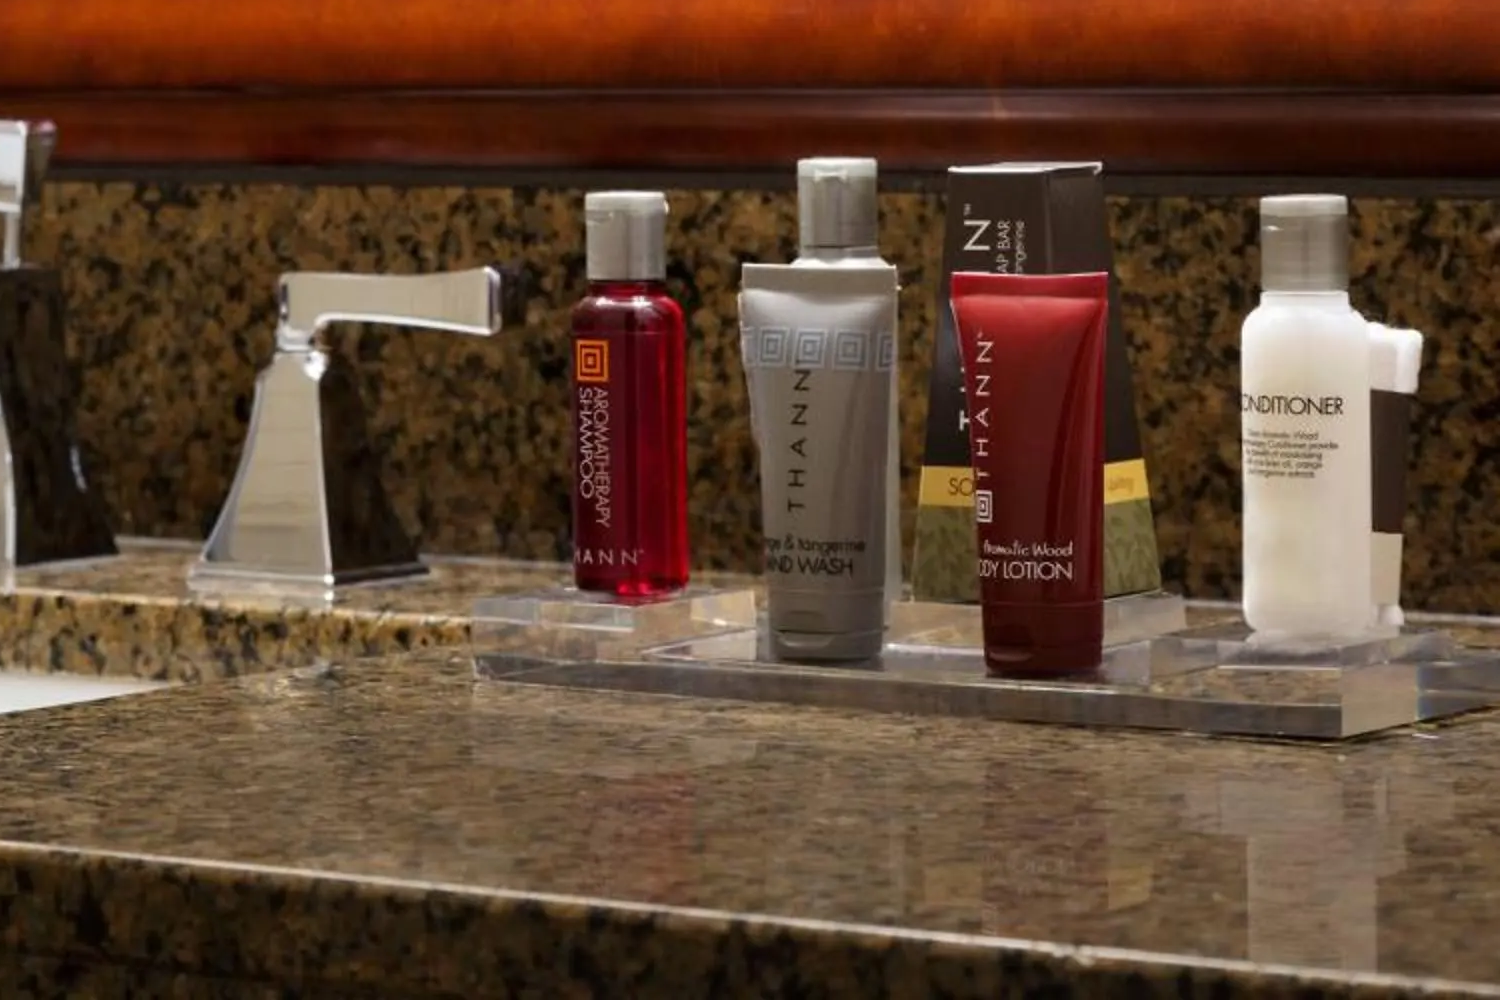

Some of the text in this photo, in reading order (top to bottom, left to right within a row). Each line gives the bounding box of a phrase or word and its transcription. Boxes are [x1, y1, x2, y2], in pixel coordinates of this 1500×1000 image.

[996, 220, 1011, 249] BAR
[974, 340, 995, 481] THANN
[1243, 394, 1344, 415] NDITIONER
[579, 387, 595, 499] SHAMPOO
[787, 369, 811, 512] THANN
[593, 386, 612, 529] AROMATHERAPY
[1032, 540, 1074, 557] Wood
[798, 555, 854, 577] WASH
[1003, 561, 1074, 580] LOTION
